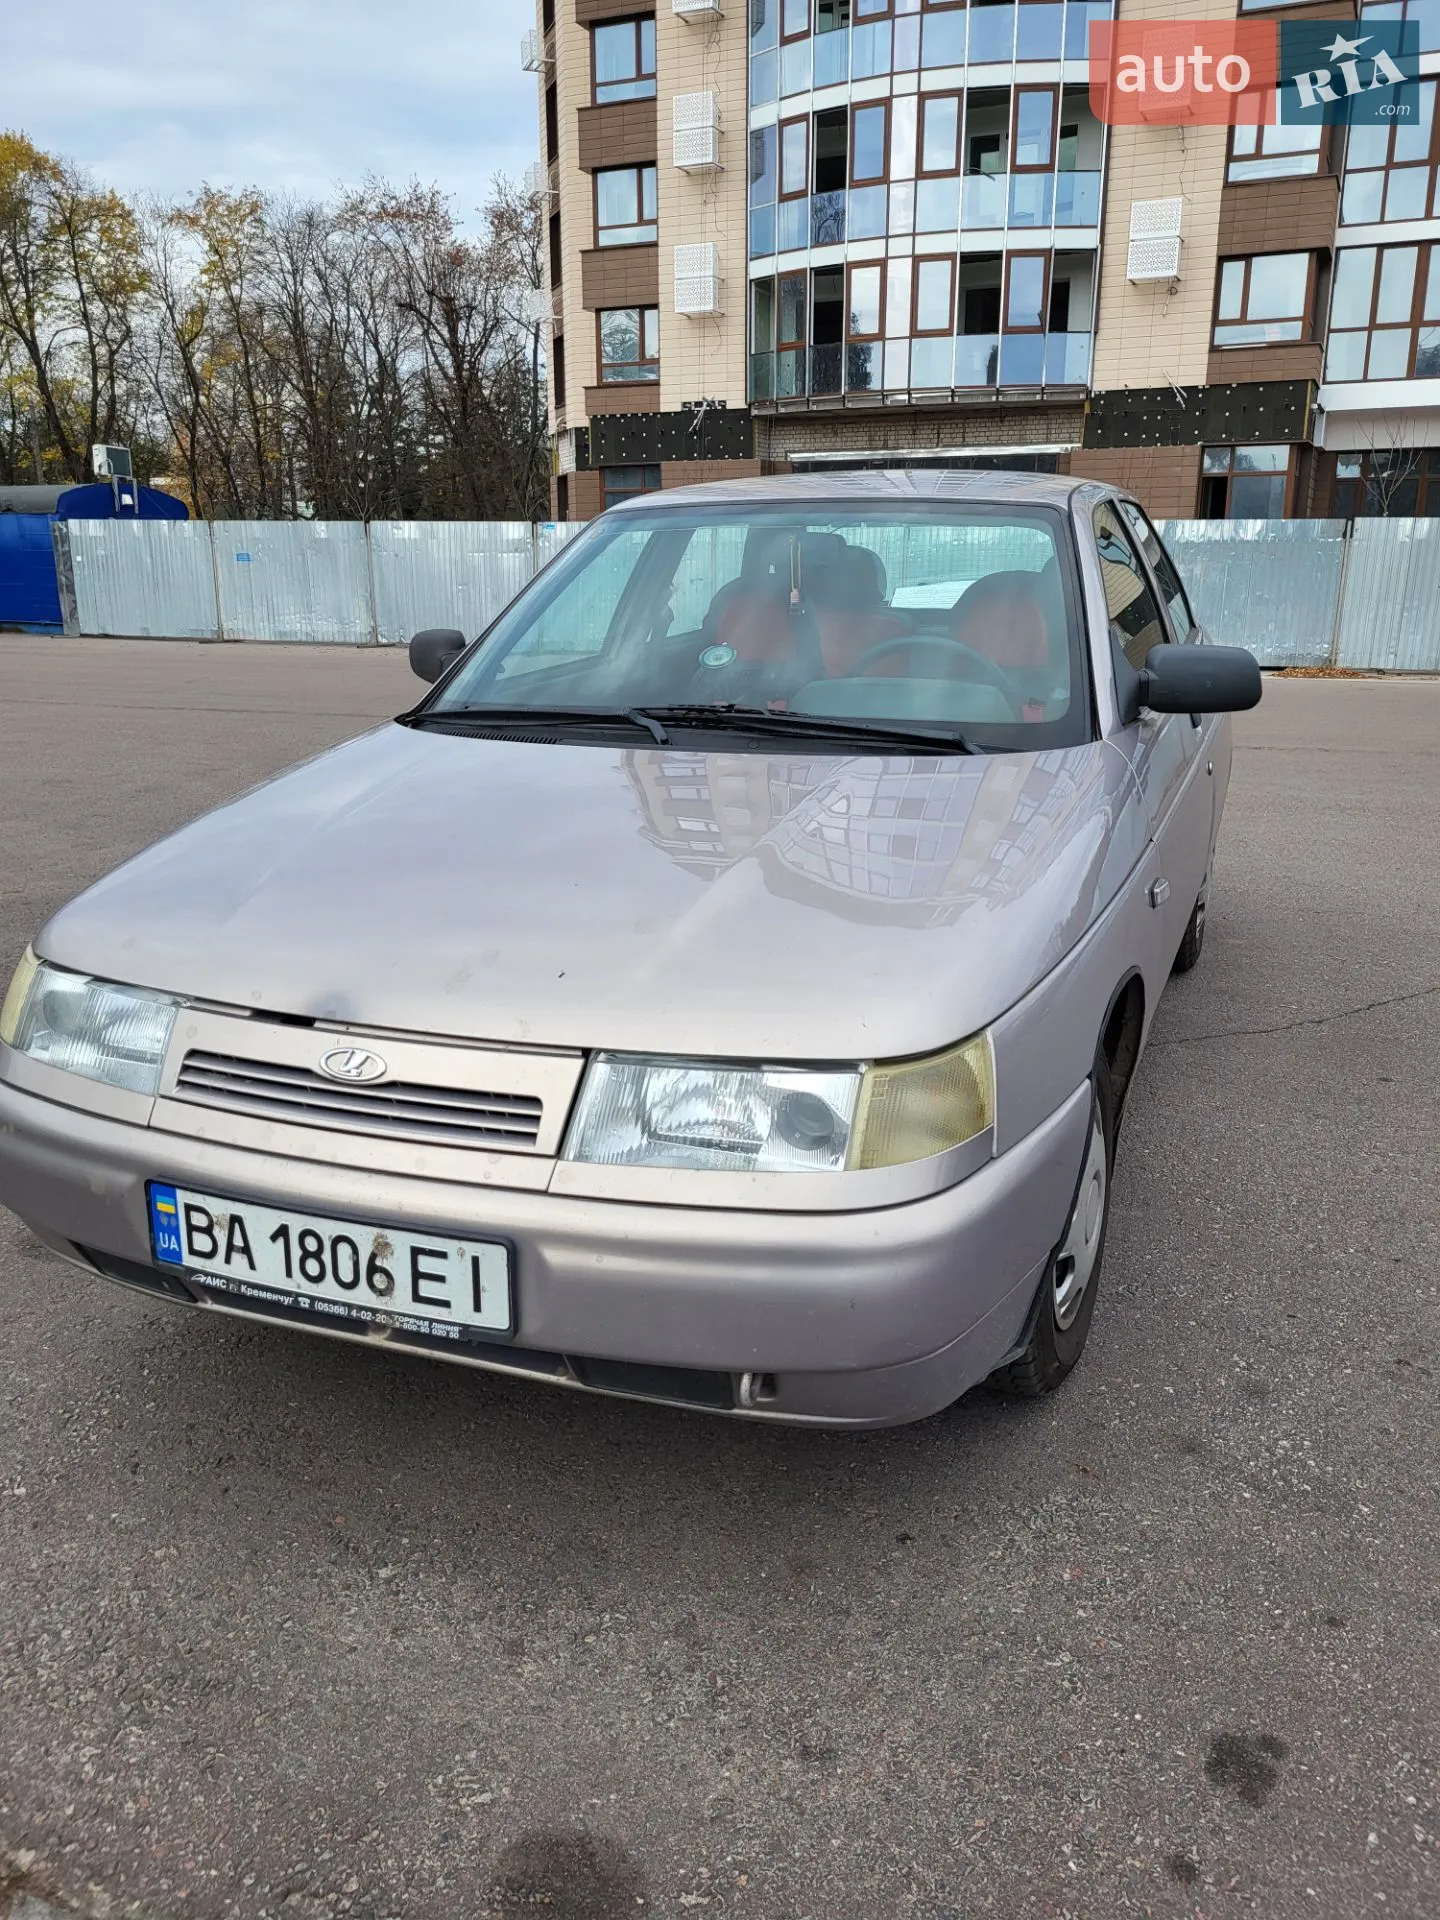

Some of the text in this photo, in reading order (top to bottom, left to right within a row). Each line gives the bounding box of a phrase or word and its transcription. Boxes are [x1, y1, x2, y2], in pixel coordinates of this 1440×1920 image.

[159, 1231, 180, 1251] UA
[183, 1202, 482, 1313] BA 1806 EI
[205, 1276, 227, 1289] АИС
[240, 1284, 294, 1305] Кременчуг
